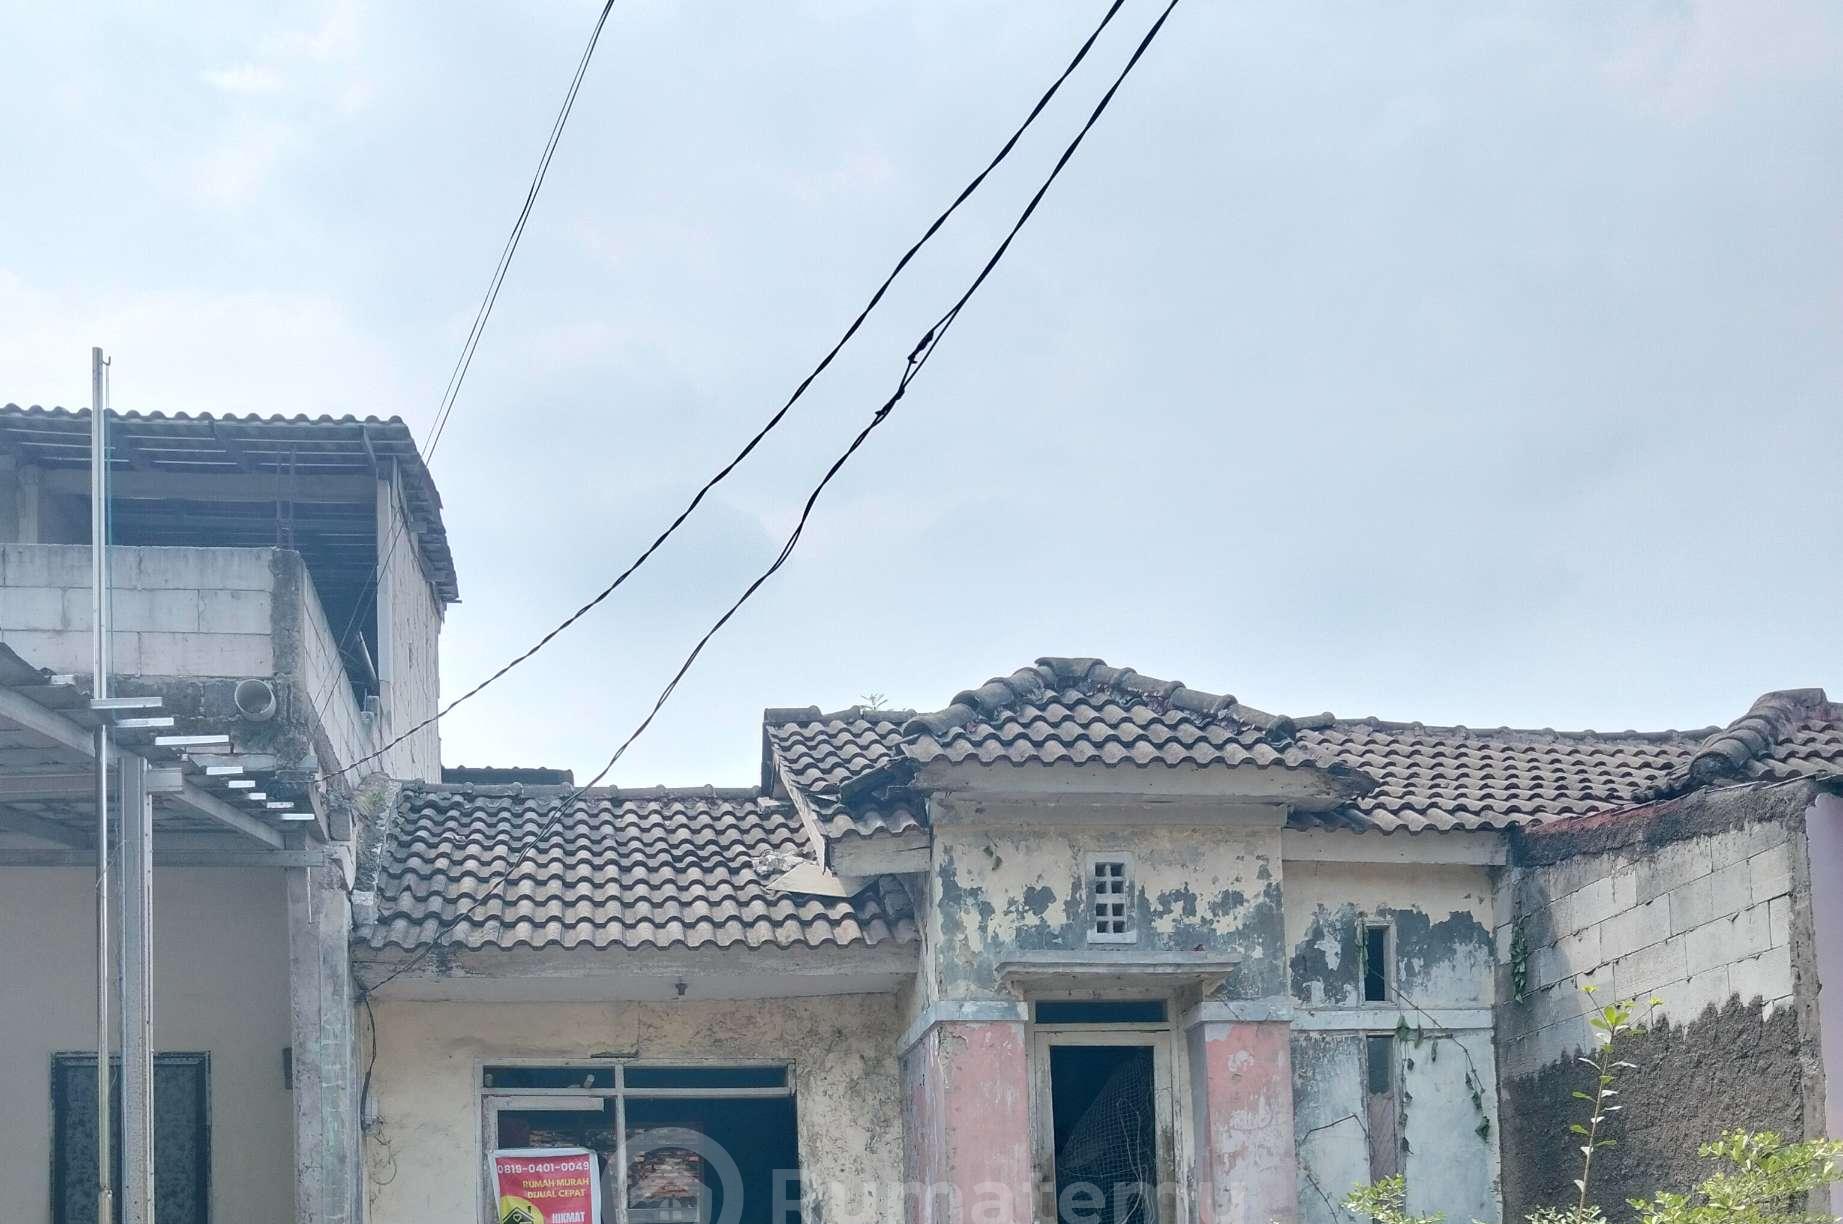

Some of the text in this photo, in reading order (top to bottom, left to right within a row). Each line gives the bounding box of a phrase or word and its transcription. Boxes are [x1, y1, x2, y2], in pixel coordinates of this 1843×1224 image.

[522, 1177, 590, 1188] RUMAH MURAH
[527, 1188, 585, 1199] DIJUAL CEPAT
[552, 1211, 585, 1224] HIKMAT
